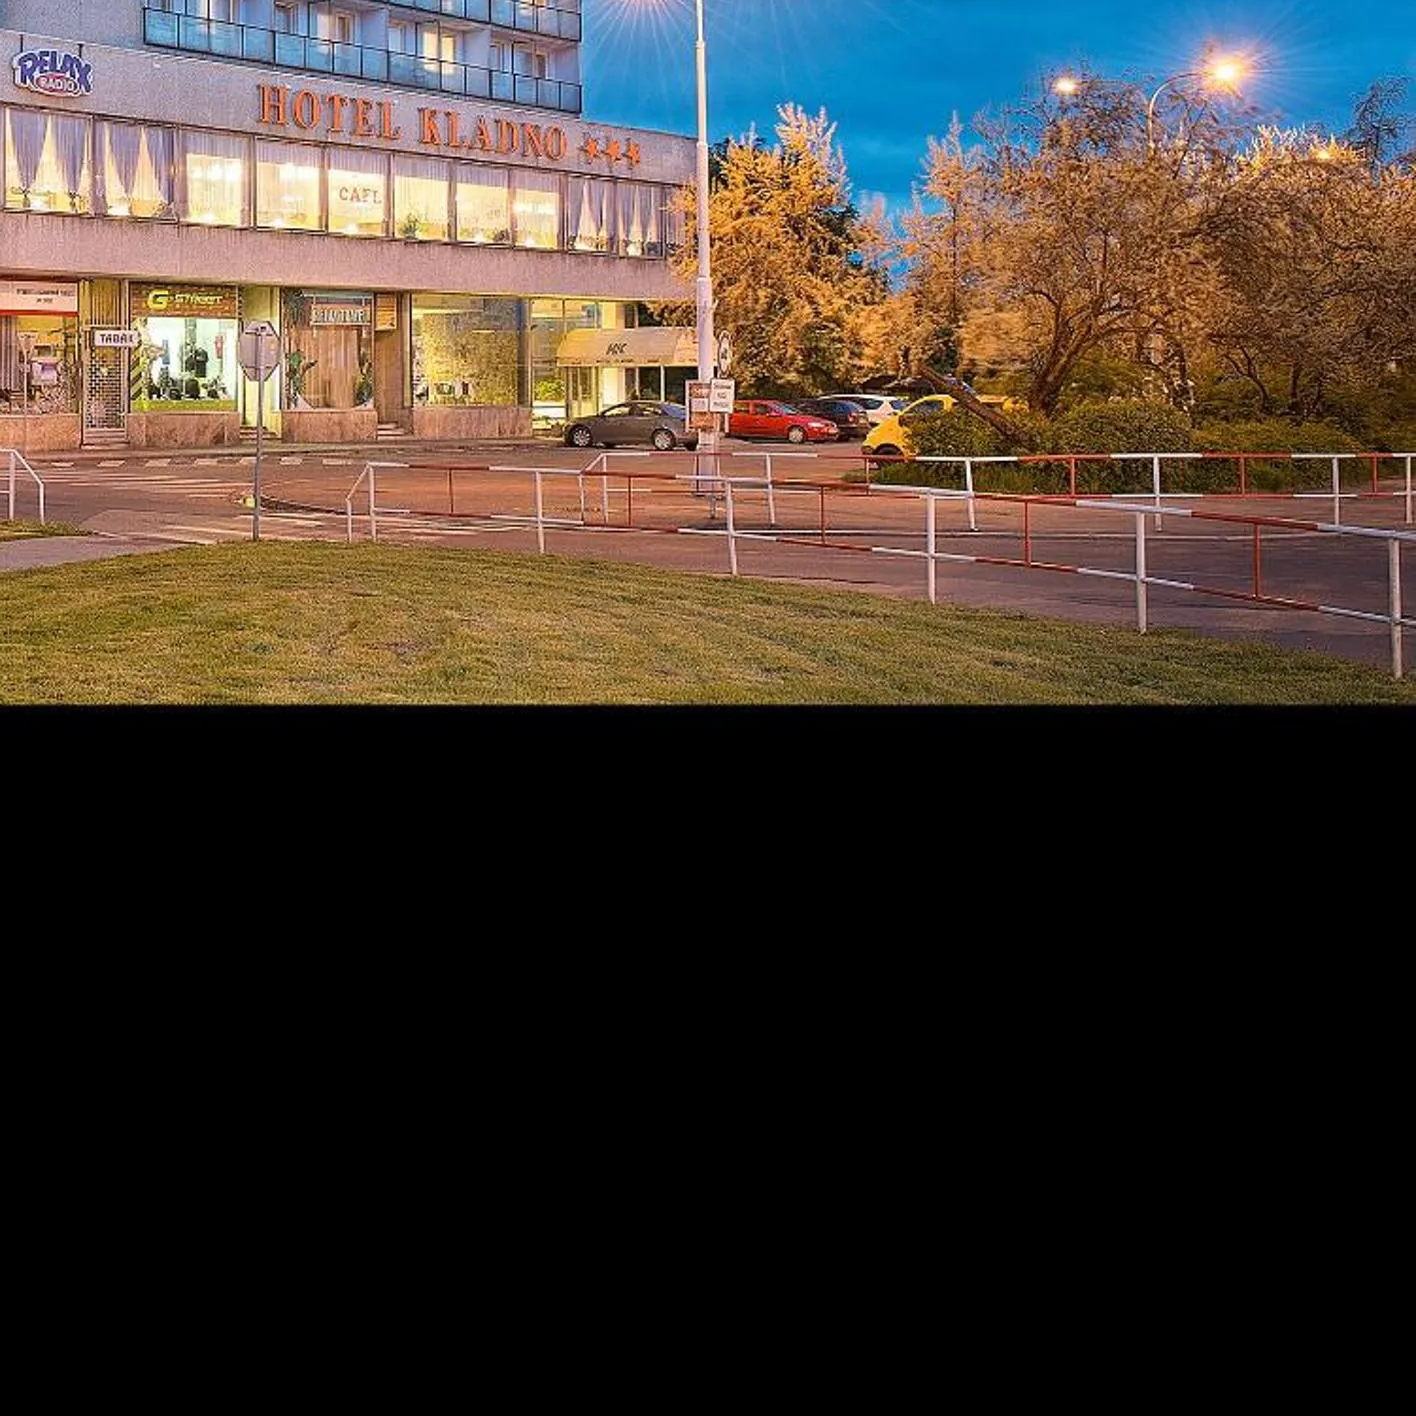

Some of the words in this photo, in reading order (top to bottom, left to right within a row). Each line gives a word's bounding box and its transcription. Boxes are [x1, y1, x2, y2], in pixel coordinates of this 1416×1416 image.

[18, 50, 92, 93] RELAX
[257, 83, 401, 141] HOTEL
[418, 106, 568, 161] KLADNO
